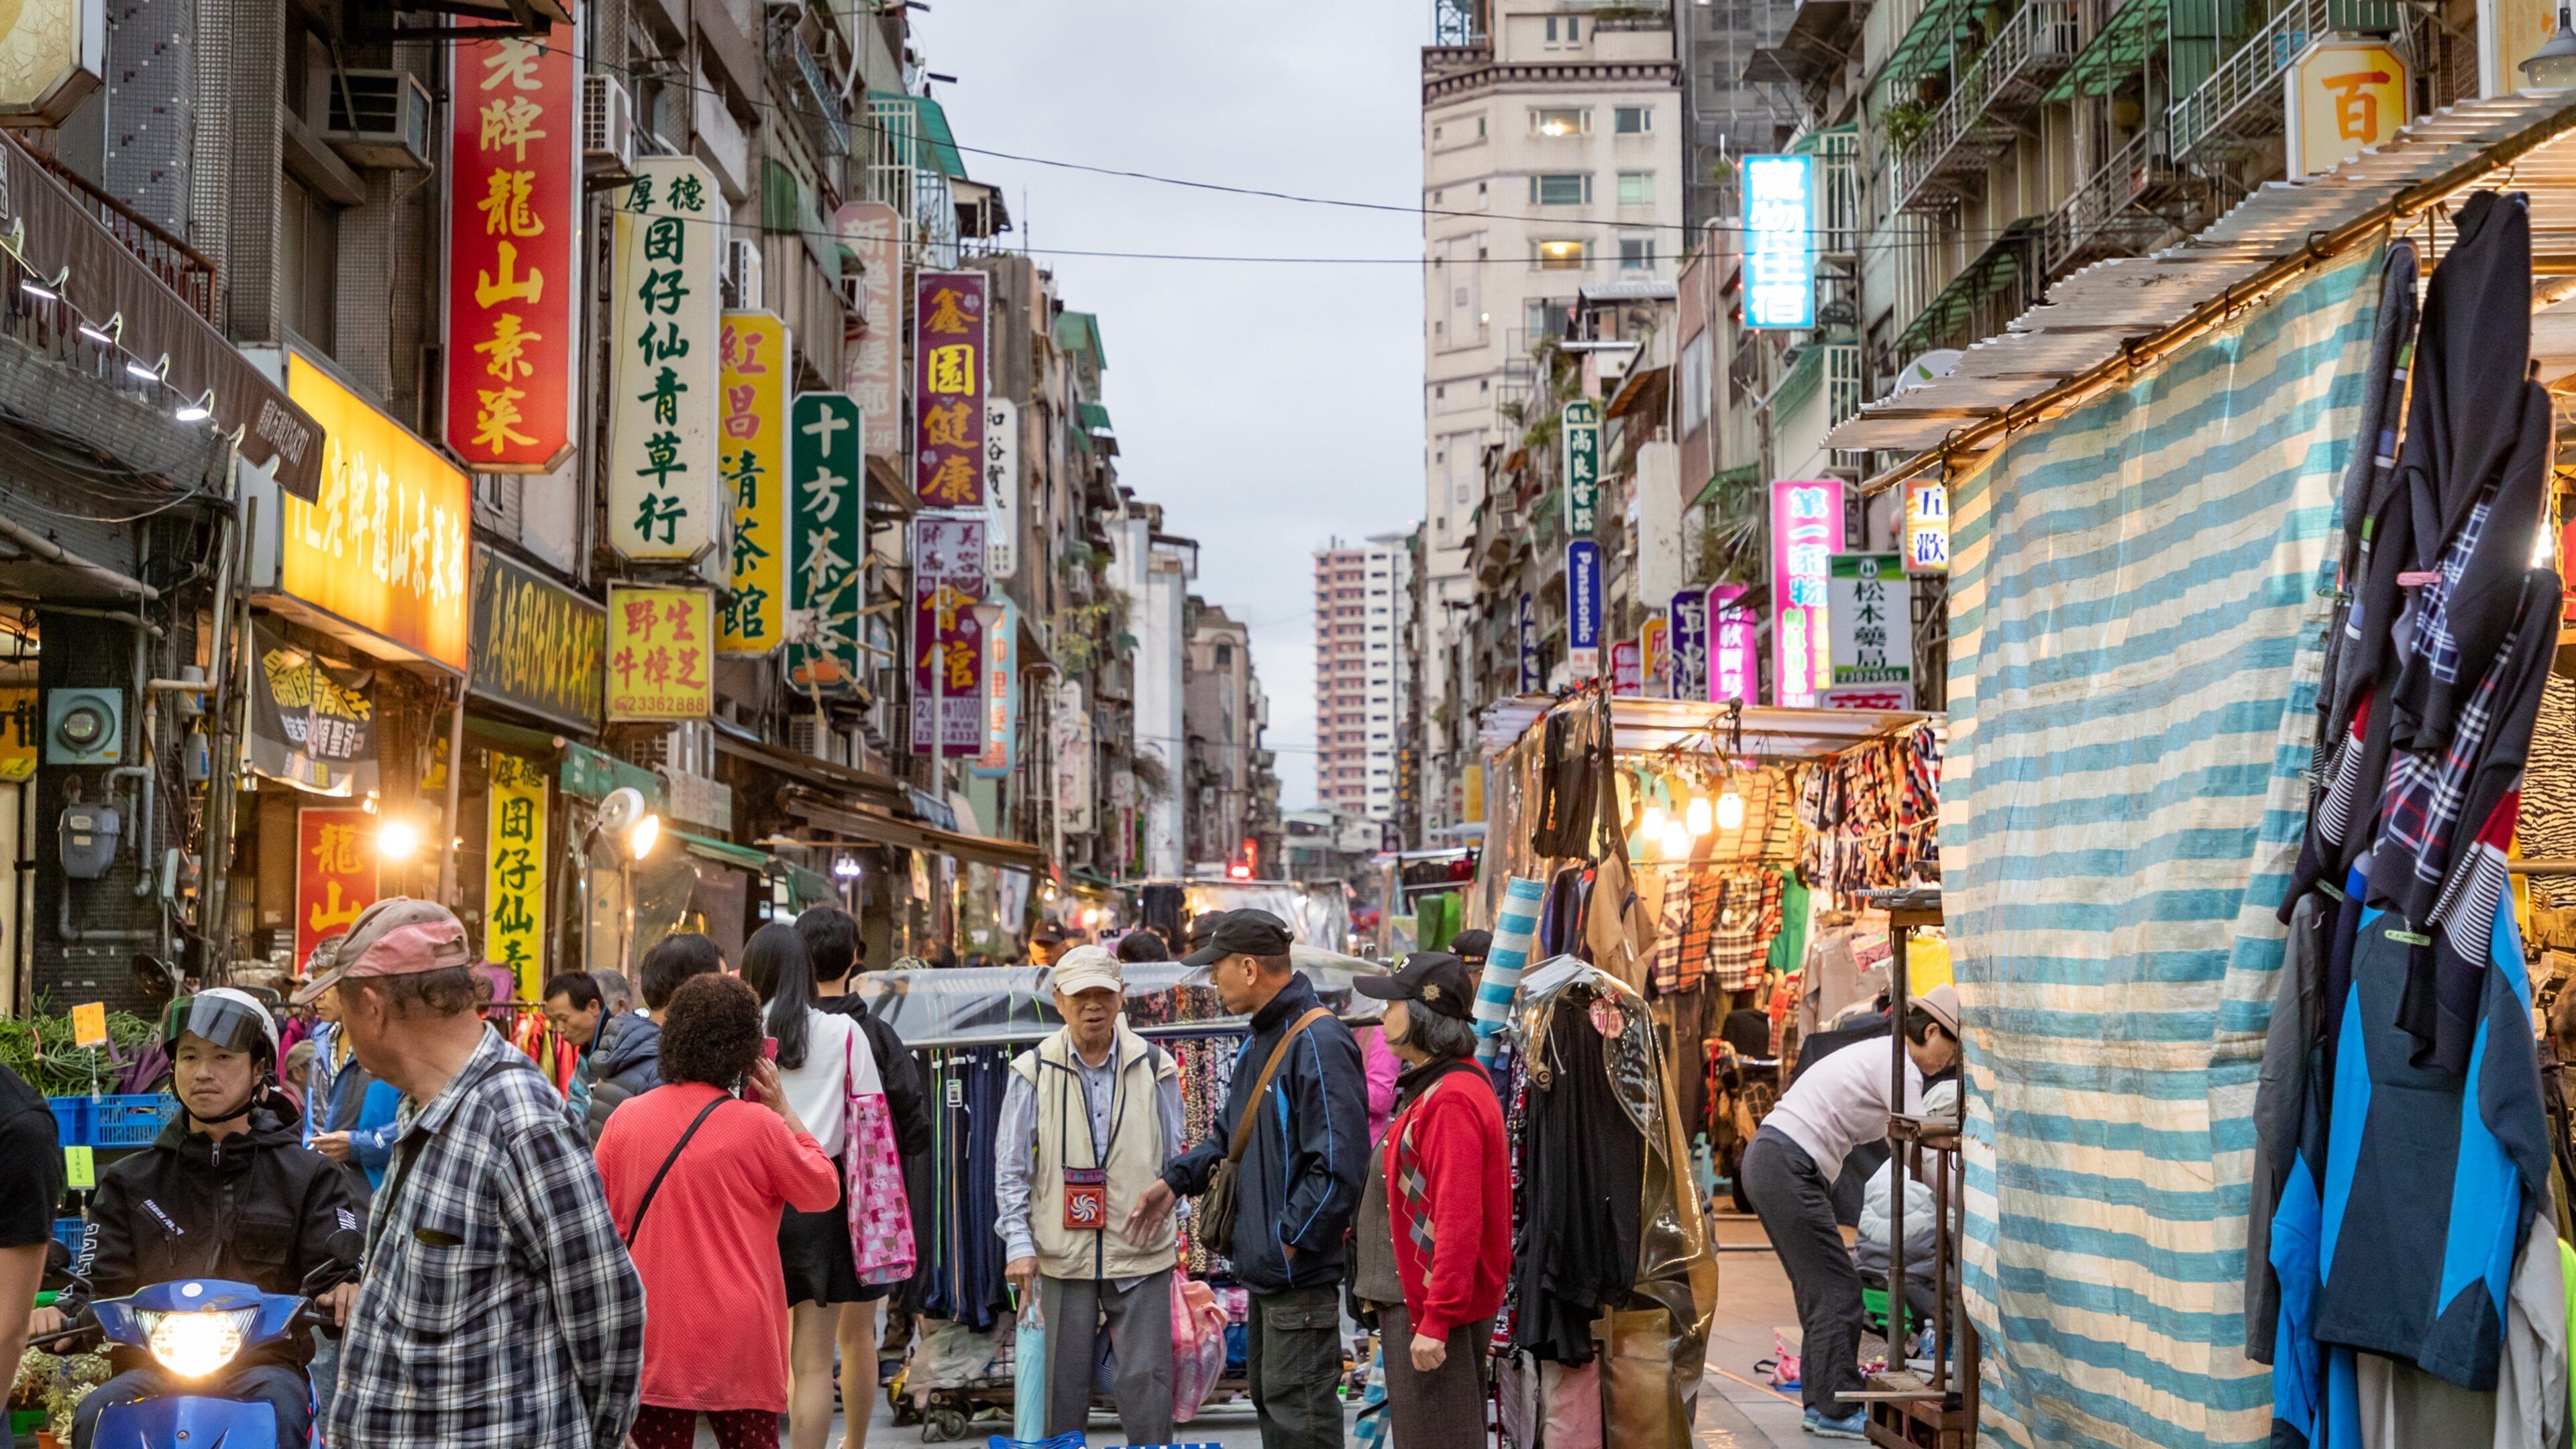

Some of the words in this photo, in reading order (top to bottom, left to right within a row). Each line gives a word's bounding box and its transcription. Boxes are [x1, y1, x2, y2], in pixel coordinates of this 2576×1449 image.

[2321, 70, 2391, 144] 百
[625, 174, 705, 213] 厚德
[472, 37, 546, 455] 老牌龍山素菜
[1750, 158, 1807, 324] 寵物住宿
[719, 325, 770, 639] 紅昌清茶館
[625, 598, 688, 642] 野生
[1576, 551, 1593, 644] Panasonic
[613, 645, 706, 694] 牛樟芝
[628, 695, 704, 712] 23362888
[309, 822, 364, 932] 龍山
